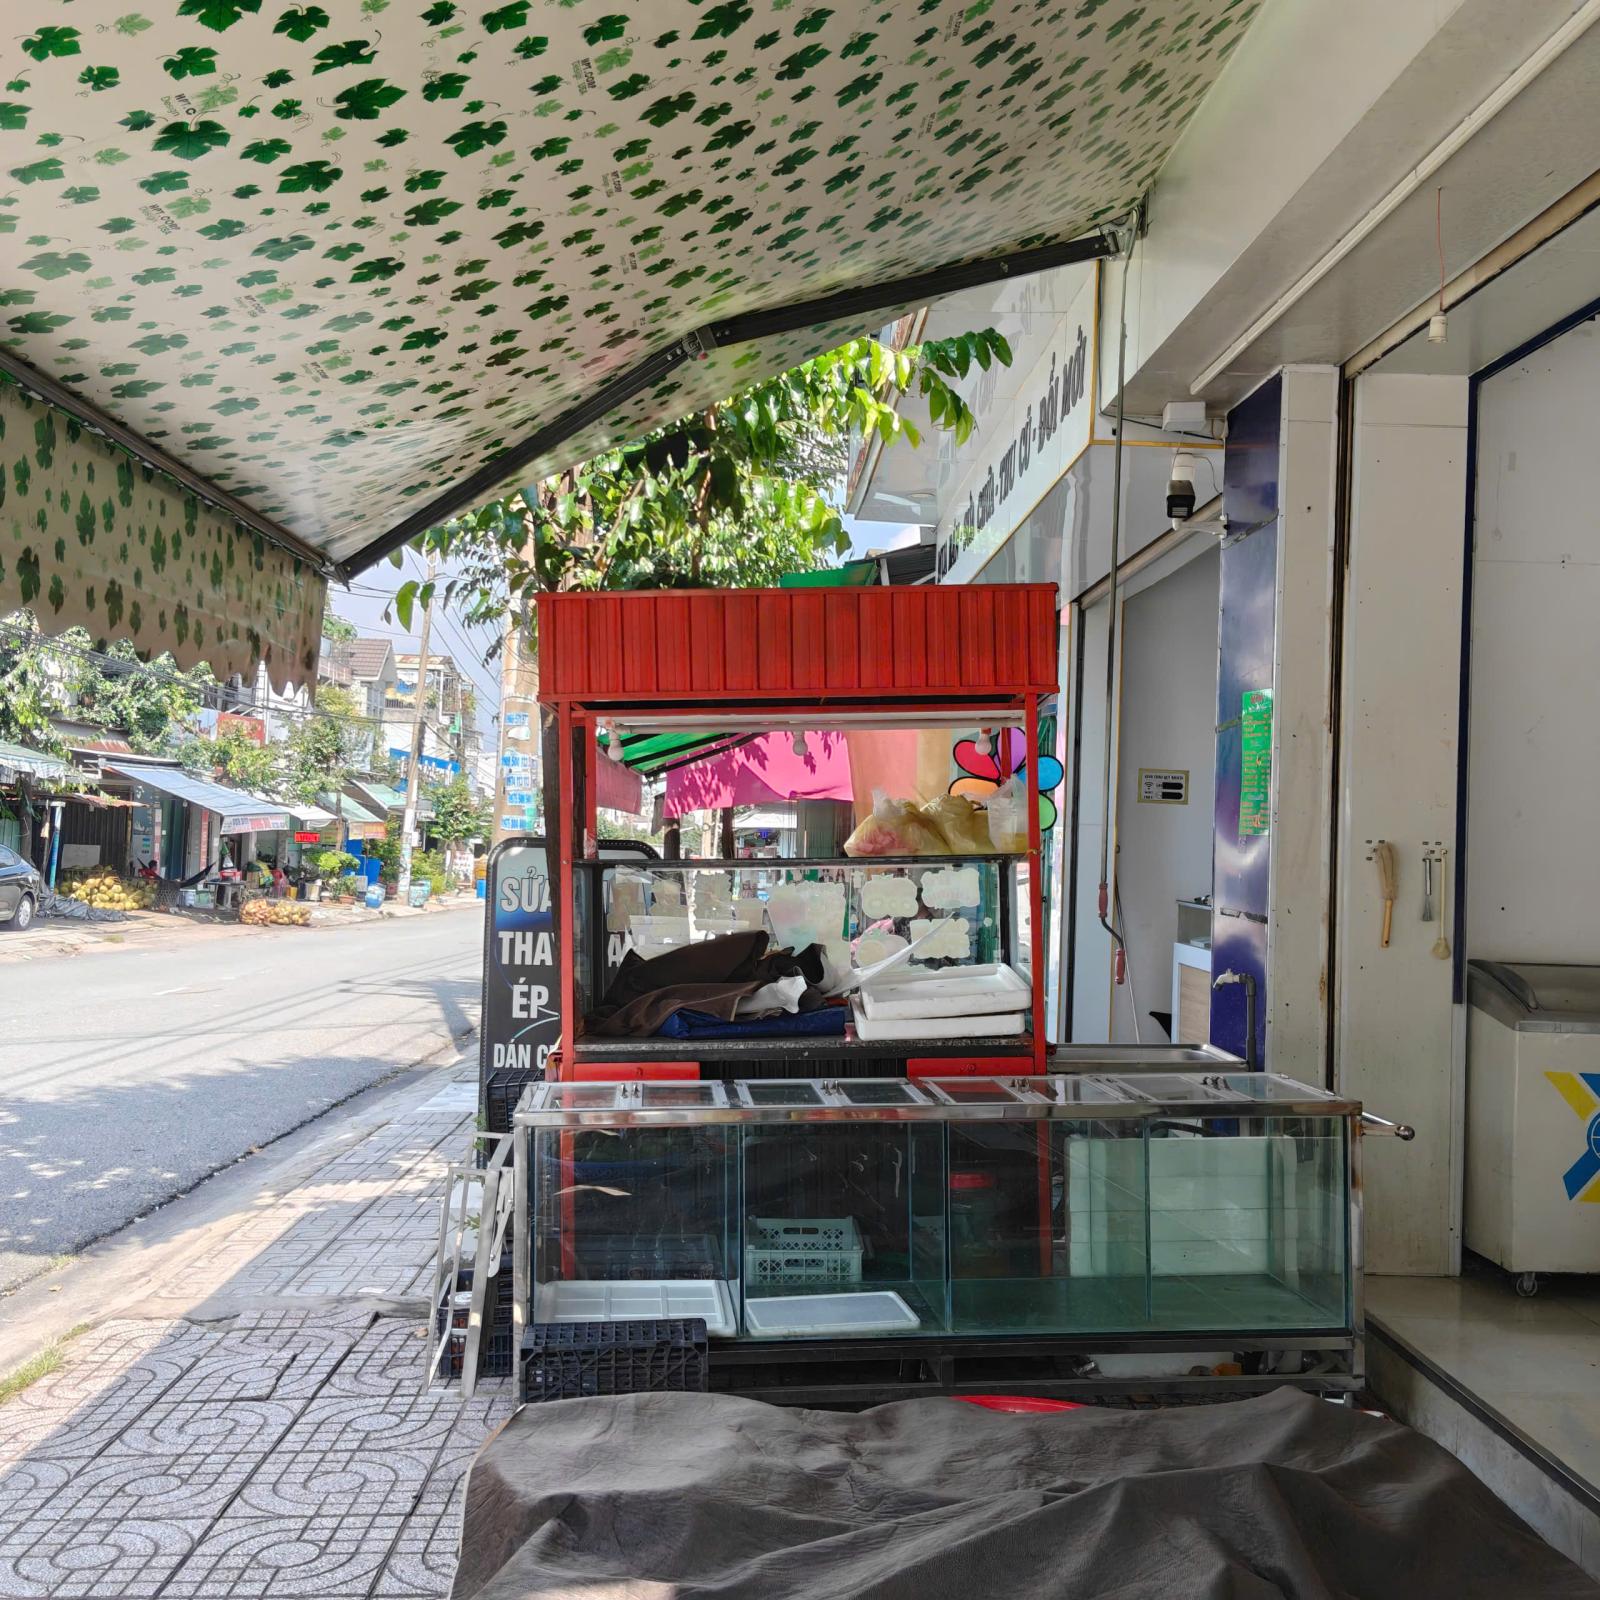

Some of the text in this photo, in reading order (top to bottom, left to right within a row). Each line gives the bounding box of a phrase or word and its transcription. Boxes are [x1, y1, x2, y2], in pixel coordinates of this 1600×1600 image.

[999, 439, 1017, 506] THU
[498, 931, 555, 966] THA
[511, 977, 549, 1019] ÉP
[493, 1038, 532, 1069] DÁN
